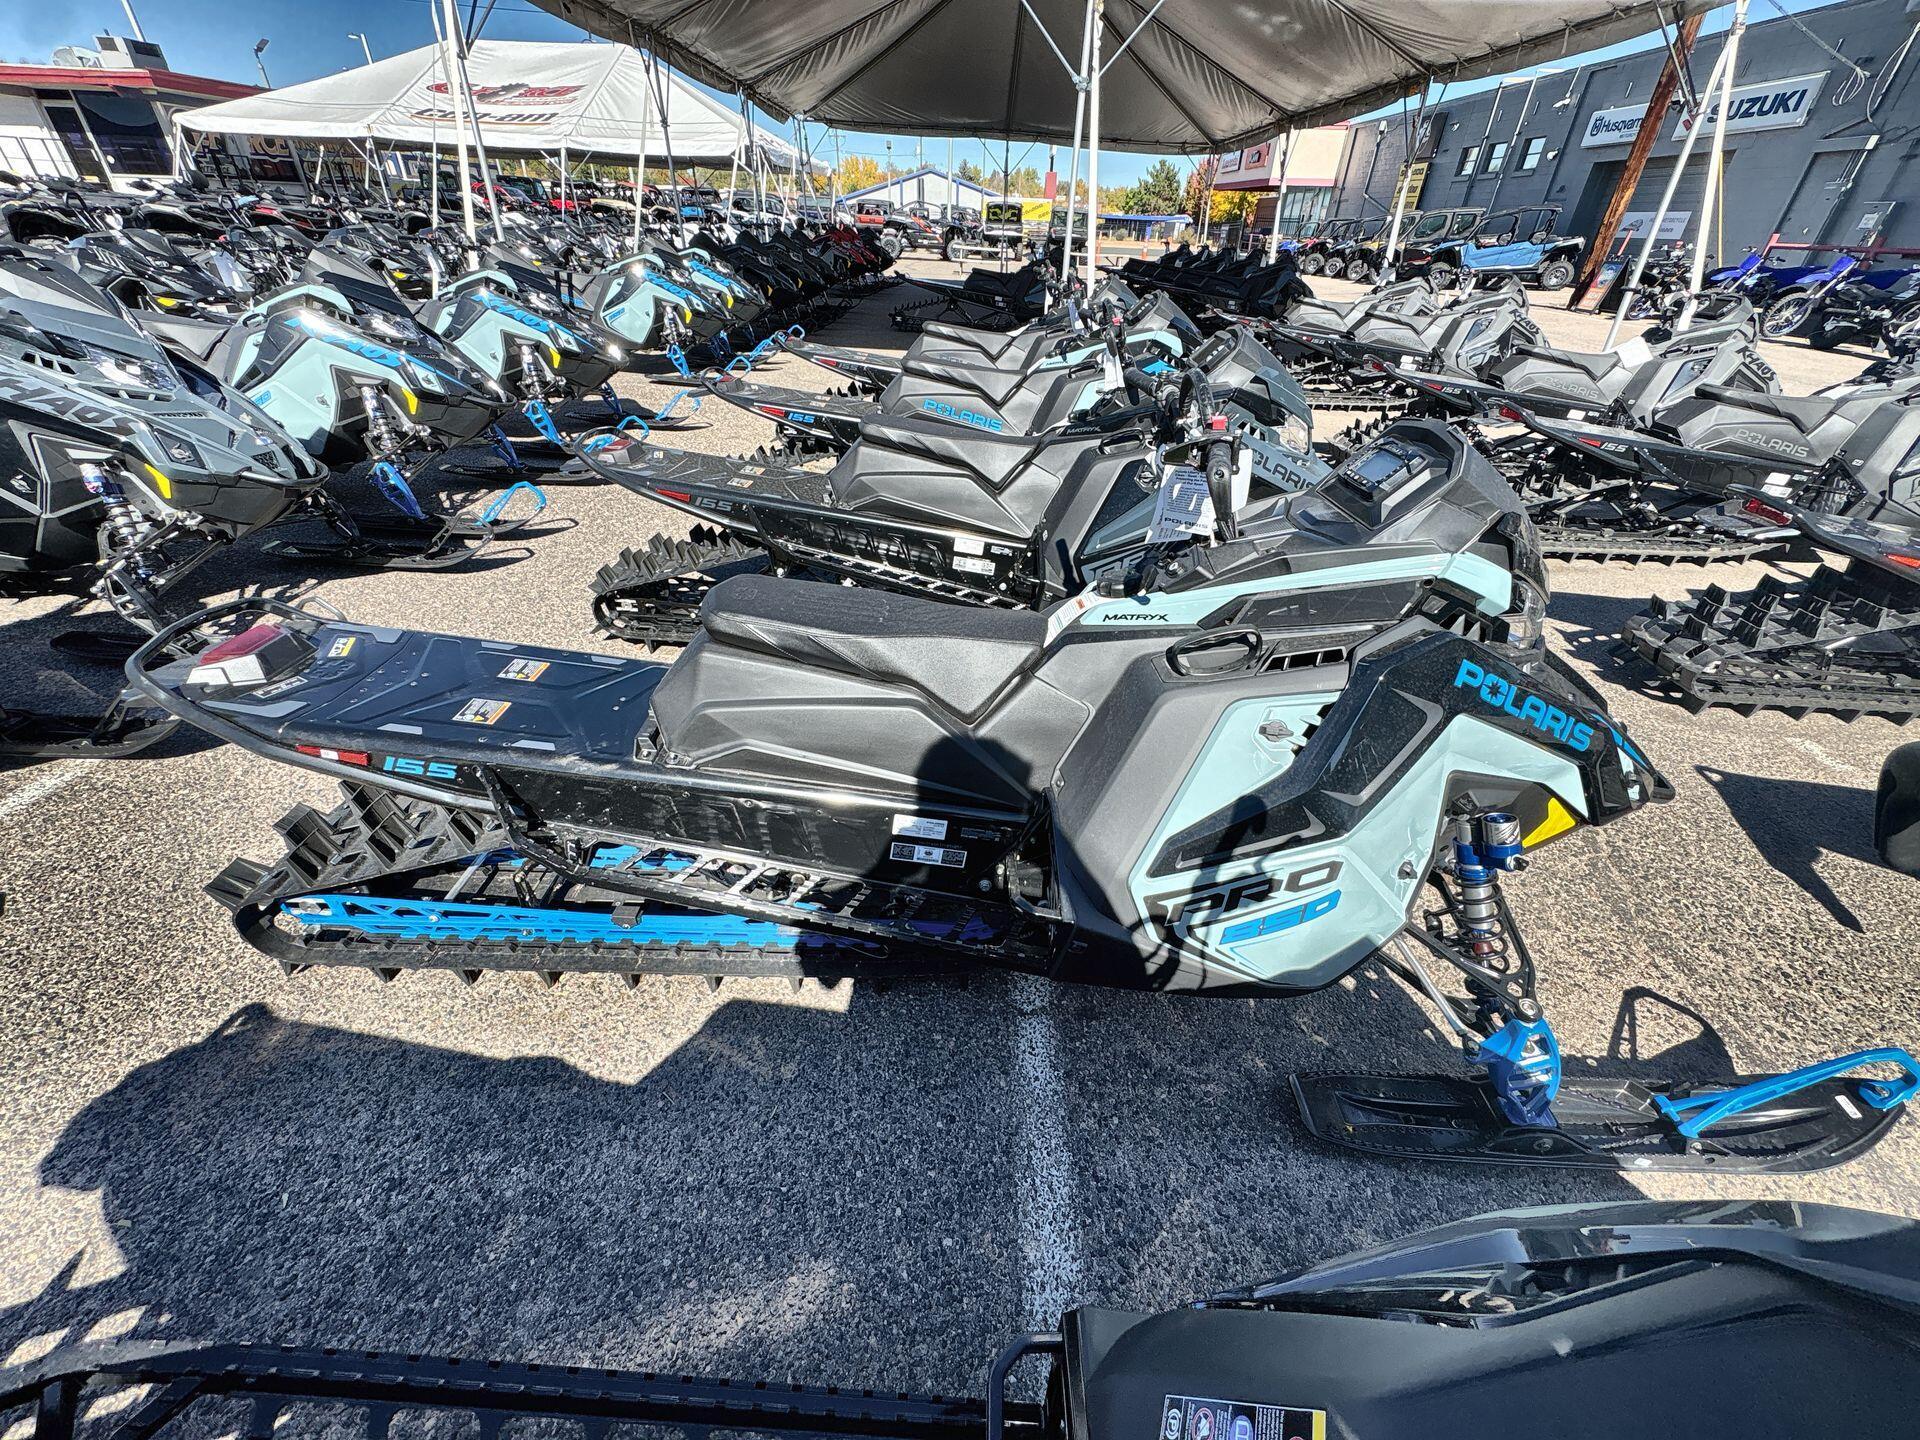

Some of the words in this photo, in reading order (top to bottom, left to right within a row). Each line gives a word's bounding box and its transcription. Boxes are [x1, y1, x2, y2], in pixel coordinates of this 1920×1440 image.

[1707, 88, 1809, 123] SUZUKI
[1509, 308, 1541, 335] KHAOS
[1736, 345, 1777, 382] KHAOS
[1441, 386, 1462, 394] 155
[1544, 376, 1599, 399] POLARIS
[787, 412, 815, 423] 155
[923, 399, 1003, 432] POLARIS
[1600, 441, 1627, 452] 155
[1734, 428, 1810, 459] POLARIS
[694, 496, 732, 512] 155
[1164, 517, 1209, 529] POLARIS
[1102, 613, 1169, 623] MATRYX
[1454, 658, 1594, 752] POLARIS
[383, 755, 458, 779] 155
[1165, 860, 1344, 926] PRO
[1219, 888, 1342, 945] 850
